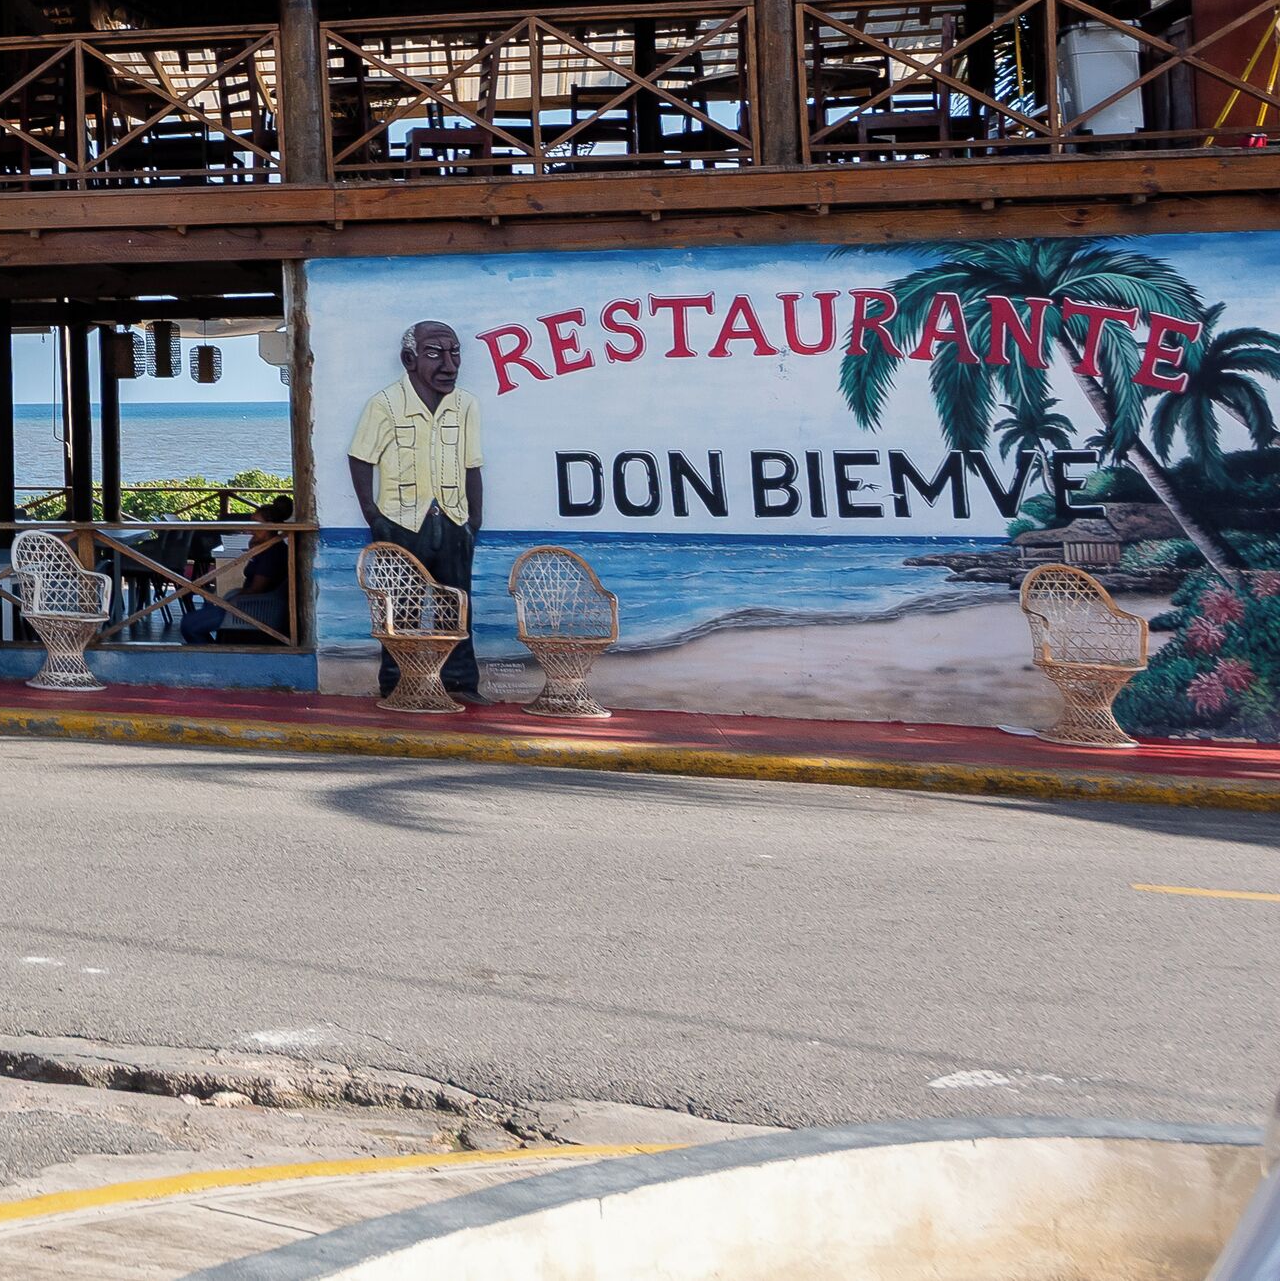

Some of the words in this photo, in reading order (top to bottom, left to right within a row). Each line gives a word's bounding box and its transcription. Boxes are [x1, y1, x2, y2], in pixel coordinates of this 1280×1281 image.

[476, 286, 1203, 397] RESTAURANTE
[555, 449, 729, 517] DON
[750, 449, 1107, 519] BIEMVE
